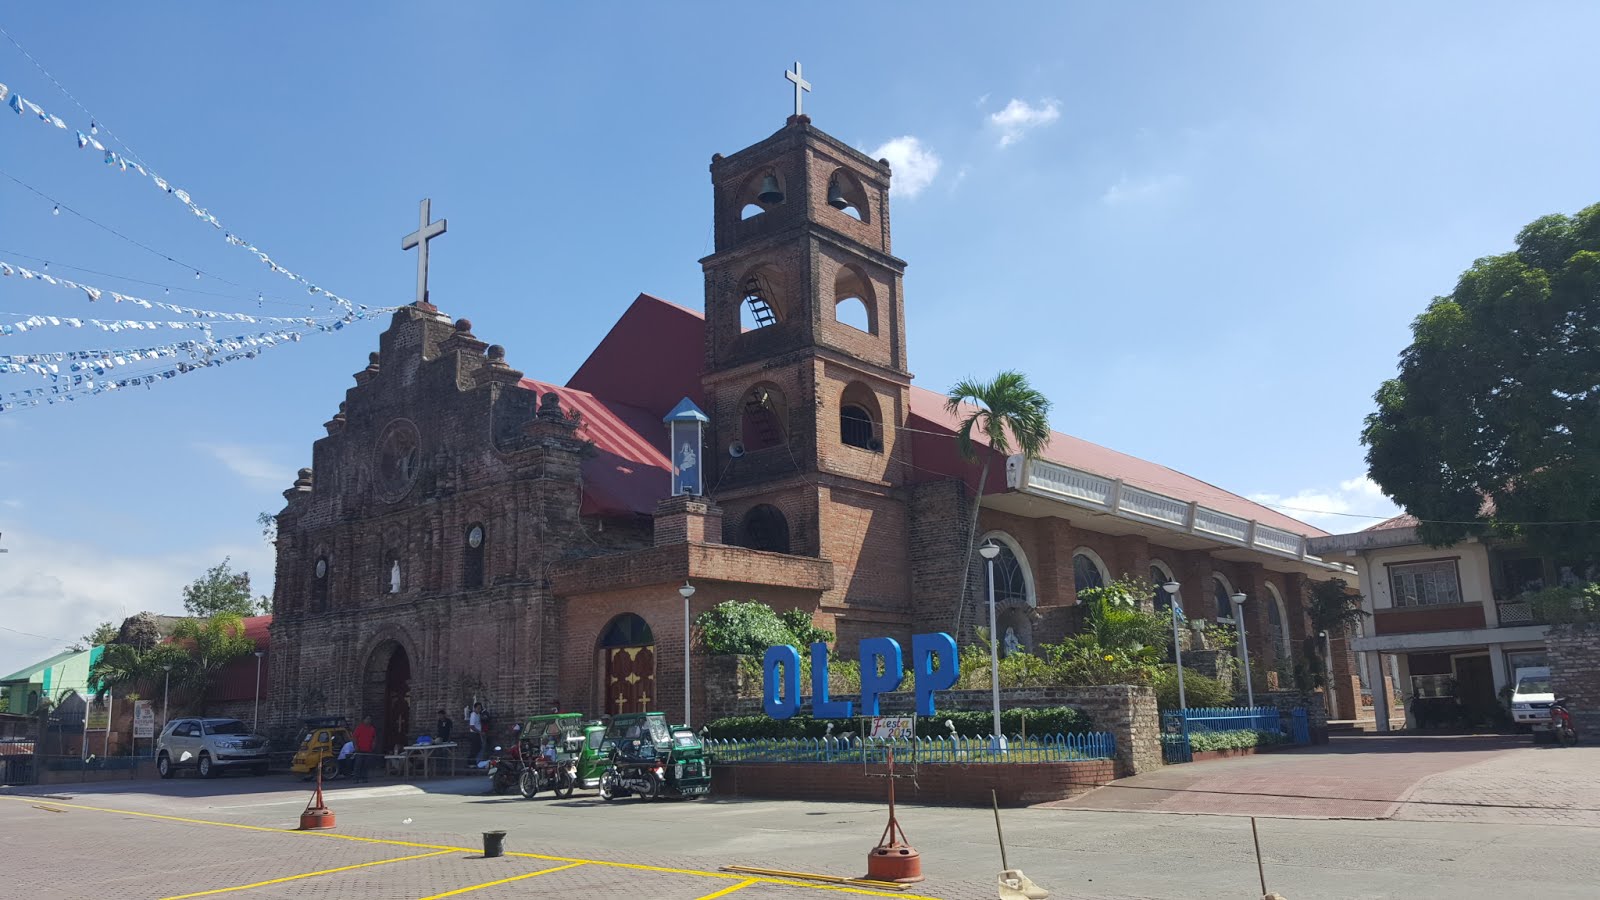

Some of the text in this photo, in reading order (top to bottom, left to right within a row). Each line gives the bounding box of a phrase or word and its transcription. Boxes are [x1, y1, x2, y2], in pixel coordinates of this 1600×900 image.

[763, 632, 960, 720] OLPP
[871, 716, 909, 737] Fiesta
[887, 728, 912, 738] 2015
